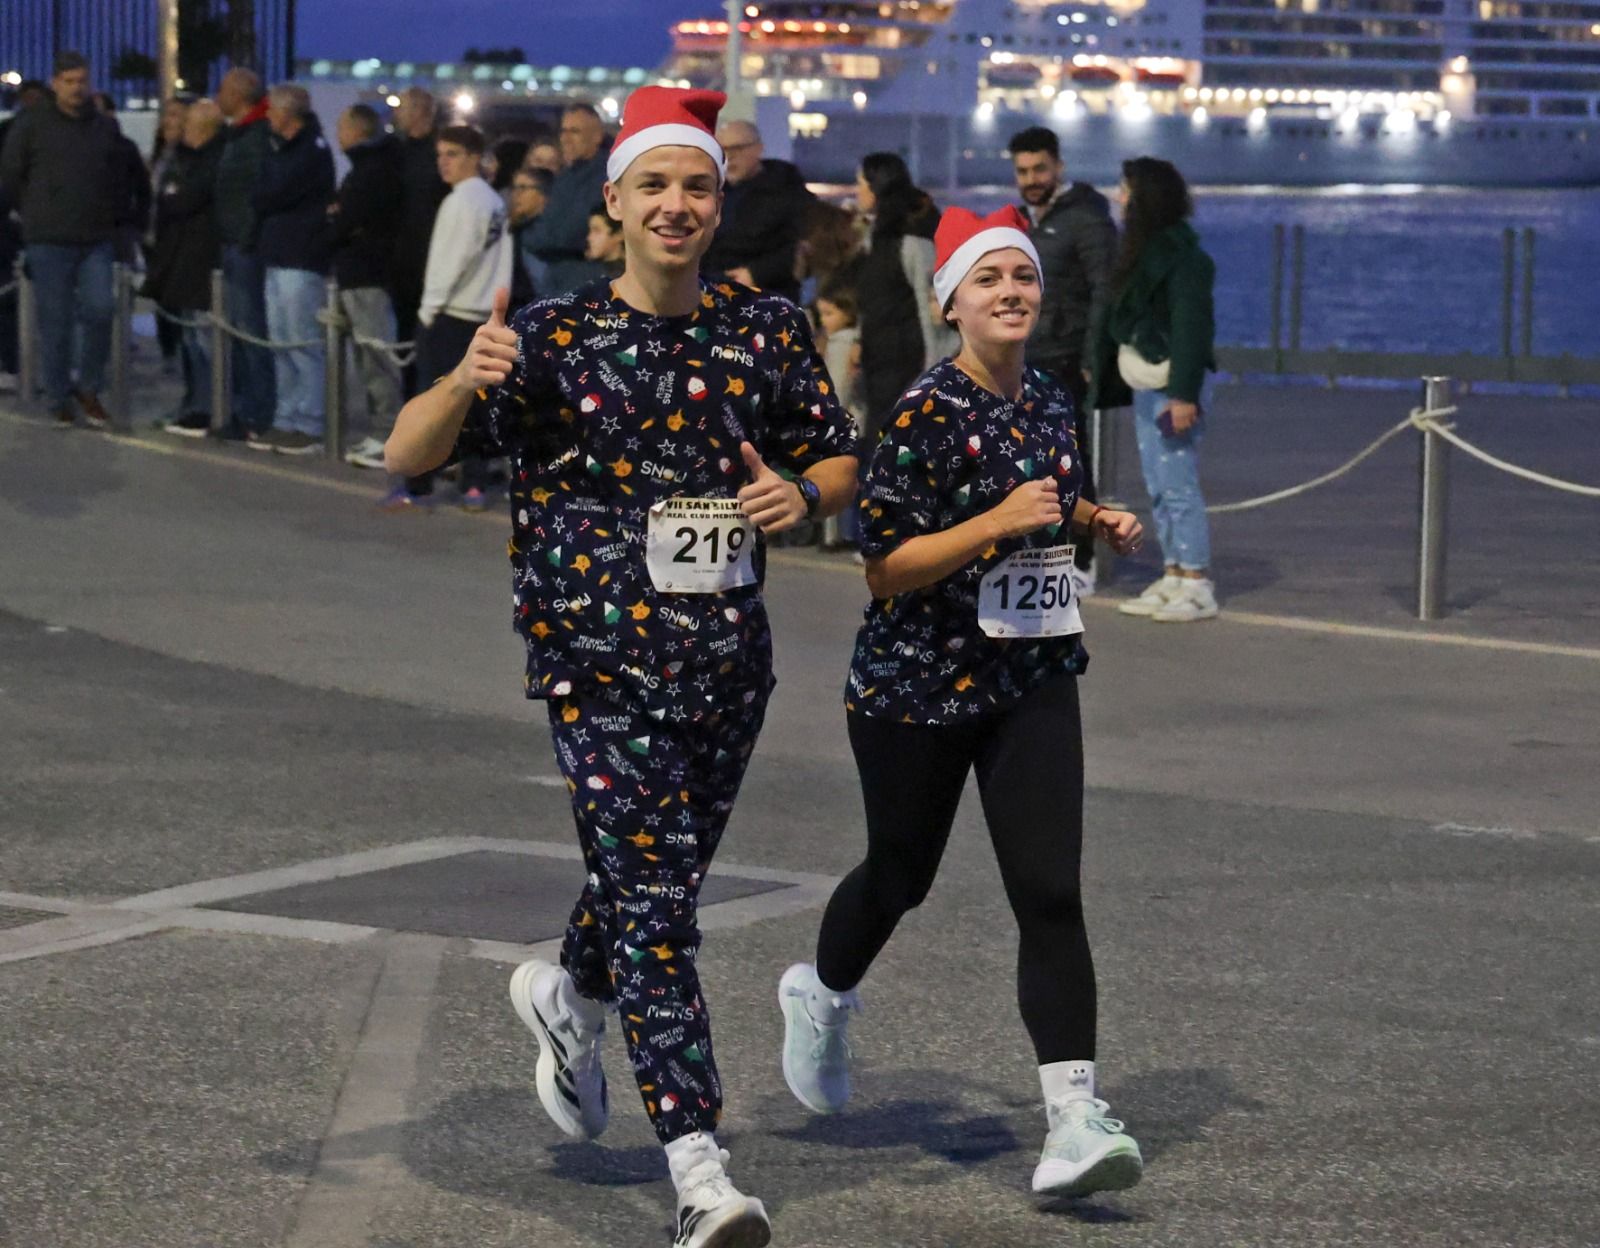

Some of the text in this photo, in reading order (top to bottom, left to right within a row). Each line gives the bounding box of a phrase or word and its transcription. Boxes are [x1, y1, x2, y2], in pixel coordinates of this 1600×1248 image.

[664, 370, 676, 405] SANTAS
[640, 460, 688, 484] SNOW
[666, 500, 683, 510] VII
[686, 500, 710, 510] SAN
[593, 540, 629, 558] SANTAS
[673, 526, 746, 564] 219
[602, 550, 627, 562] CREW
[1019, 551, 1041, 560] SAN
[993, 573, 1070, 610] 1250
[658, 607, 700, 631] SNOW
[591, 715, 632, 725] SANTAS
[601, 723, 630, 733] CREW
[649, 1025, 685, 1045] SANTAS
